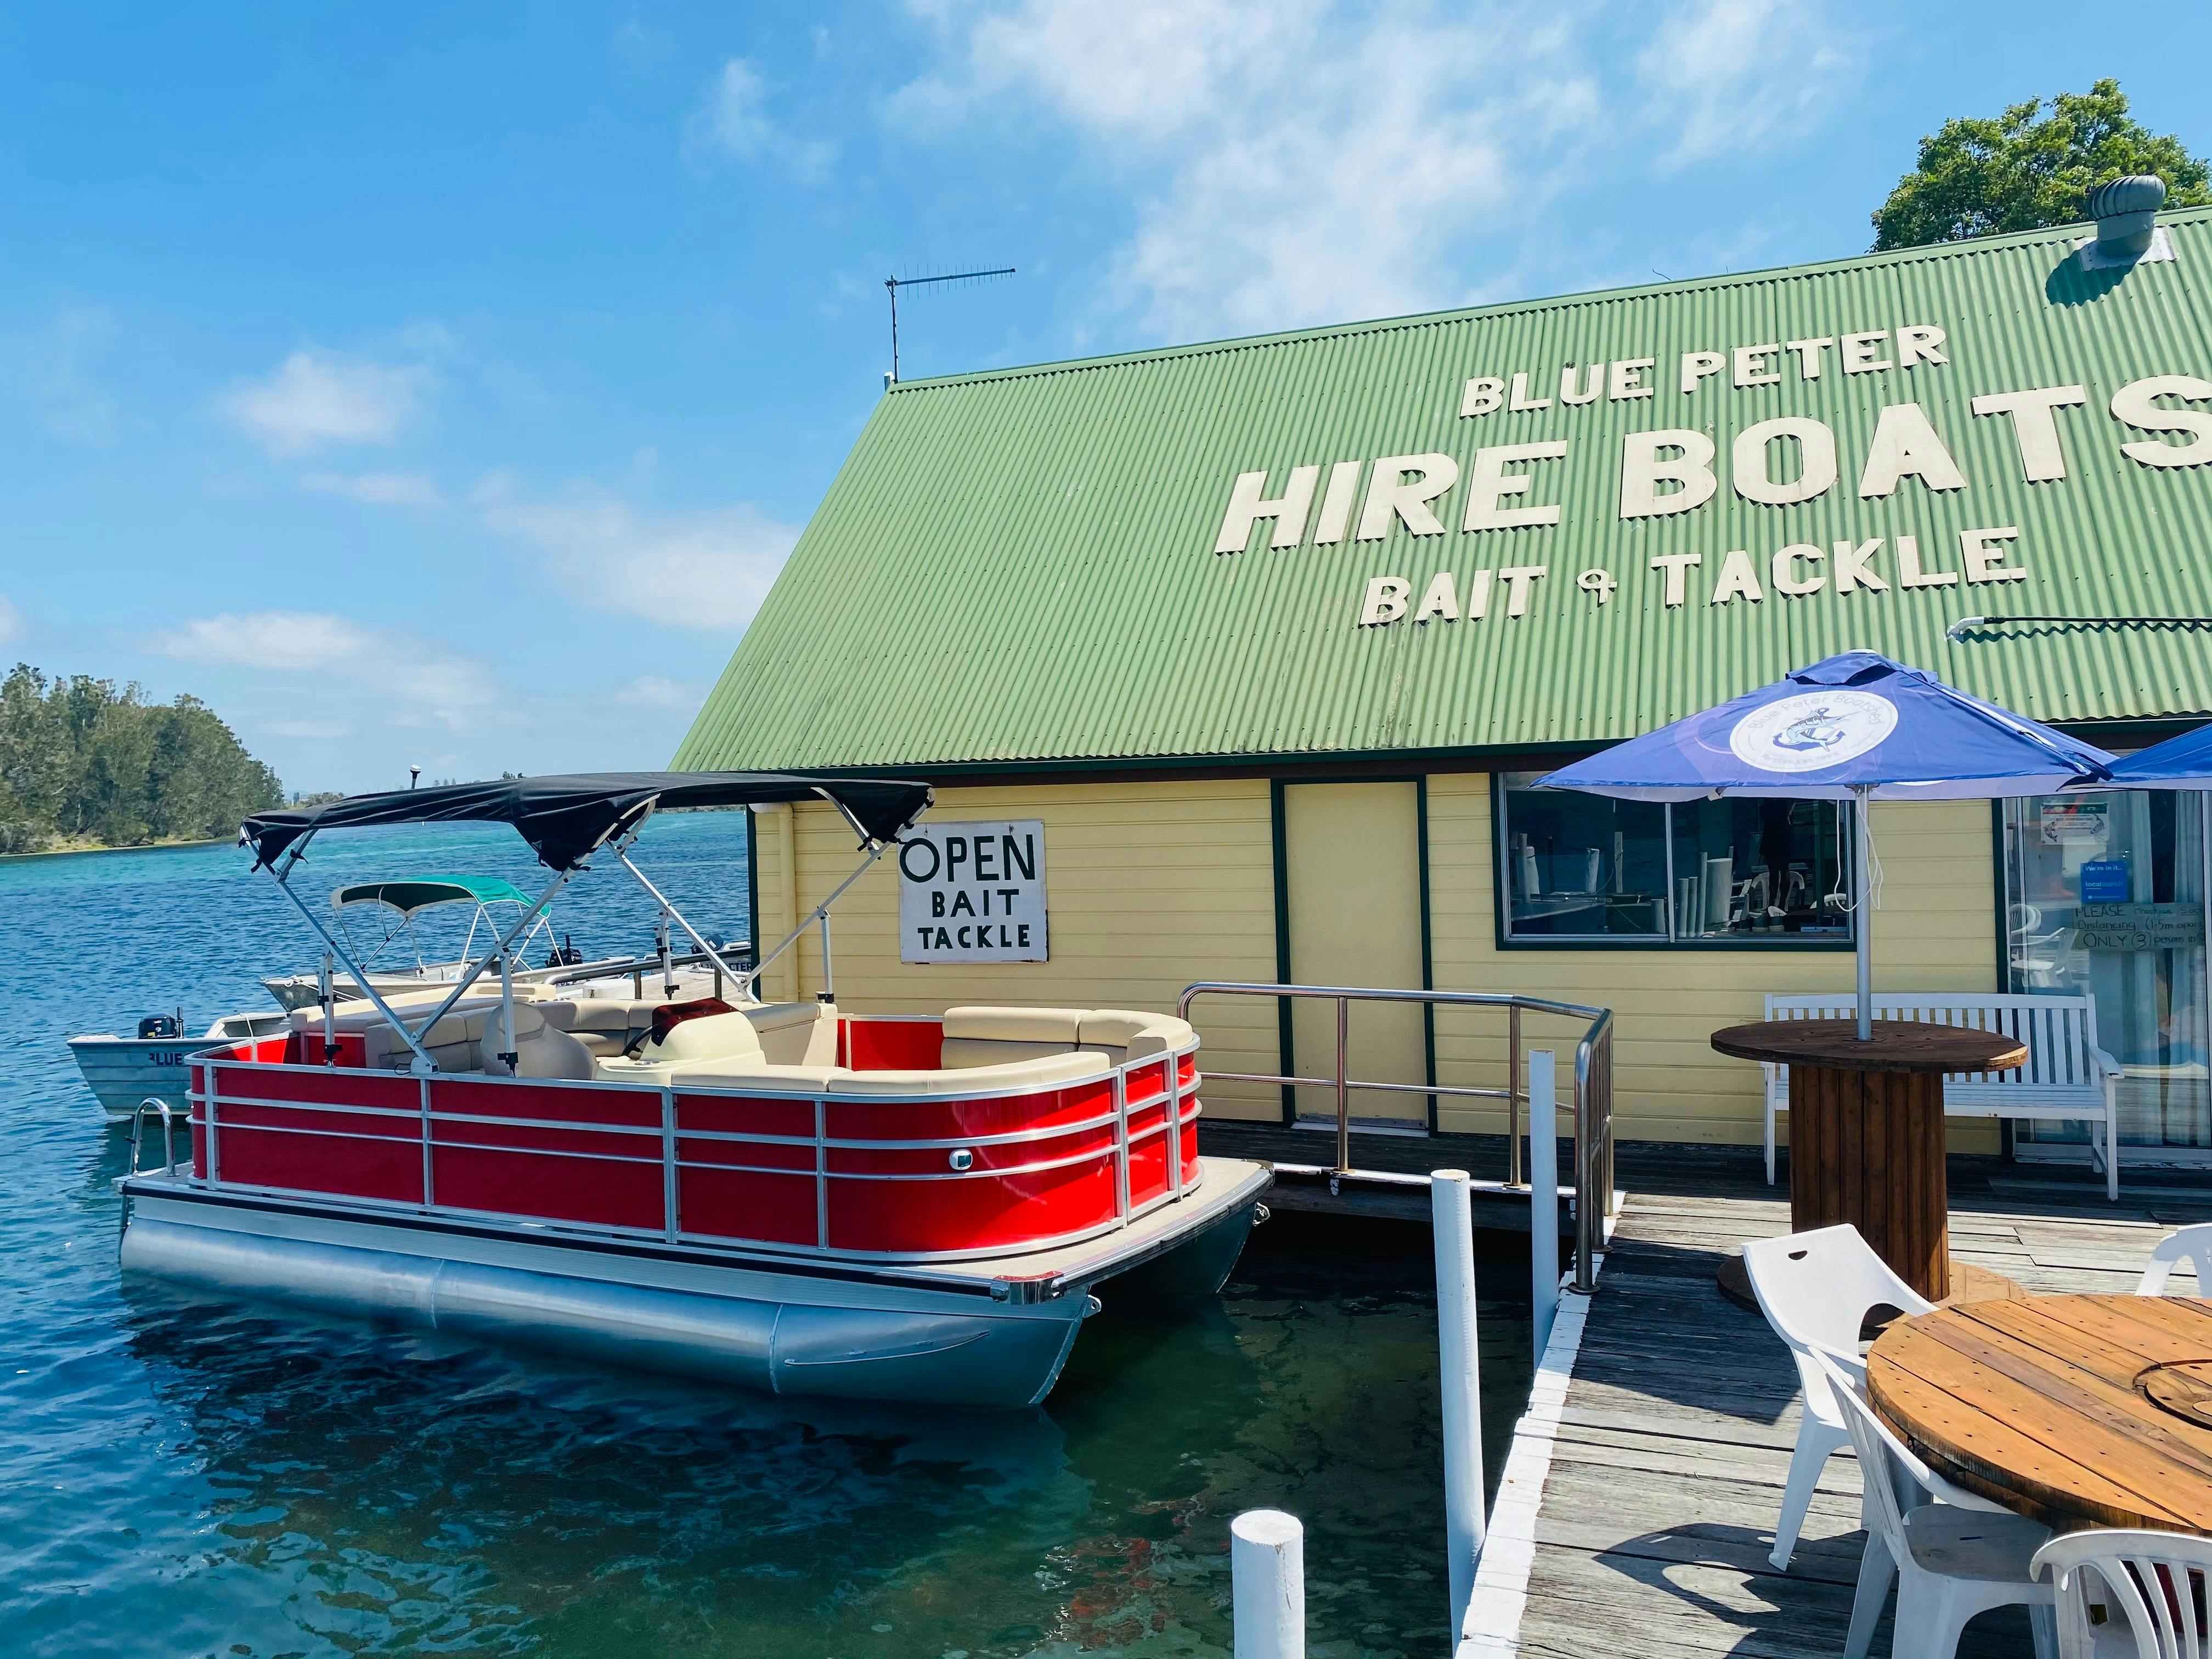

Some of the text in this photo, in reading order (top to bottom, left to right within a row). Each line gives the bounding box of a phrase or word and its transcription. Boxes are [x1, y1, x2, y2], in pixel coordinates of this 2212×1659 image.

[1460, 325, 1949, 417] BLUE PETER
[1214, 375, 2212, 553] HIRE BOATS
[1359, 566, 1547, 626] BAIT
[1651, 526, 2027, 605] TACKLE
[1748, 710, 1780, 729] Blue
[1833, 695, 1886, 724] Boatshed
[900, 834, 1035, 883] OPEN
[932, 889, 1019, 917] BAIT
[2075, 905, 2126, 917] PLEASE
[917, 924, 1030, 949] TACKLE
[2078, 919, 2136, 932] Distancing
[2084, 933, 2127, 947] ONLY
[2154, 936, 2186, 946] persons
